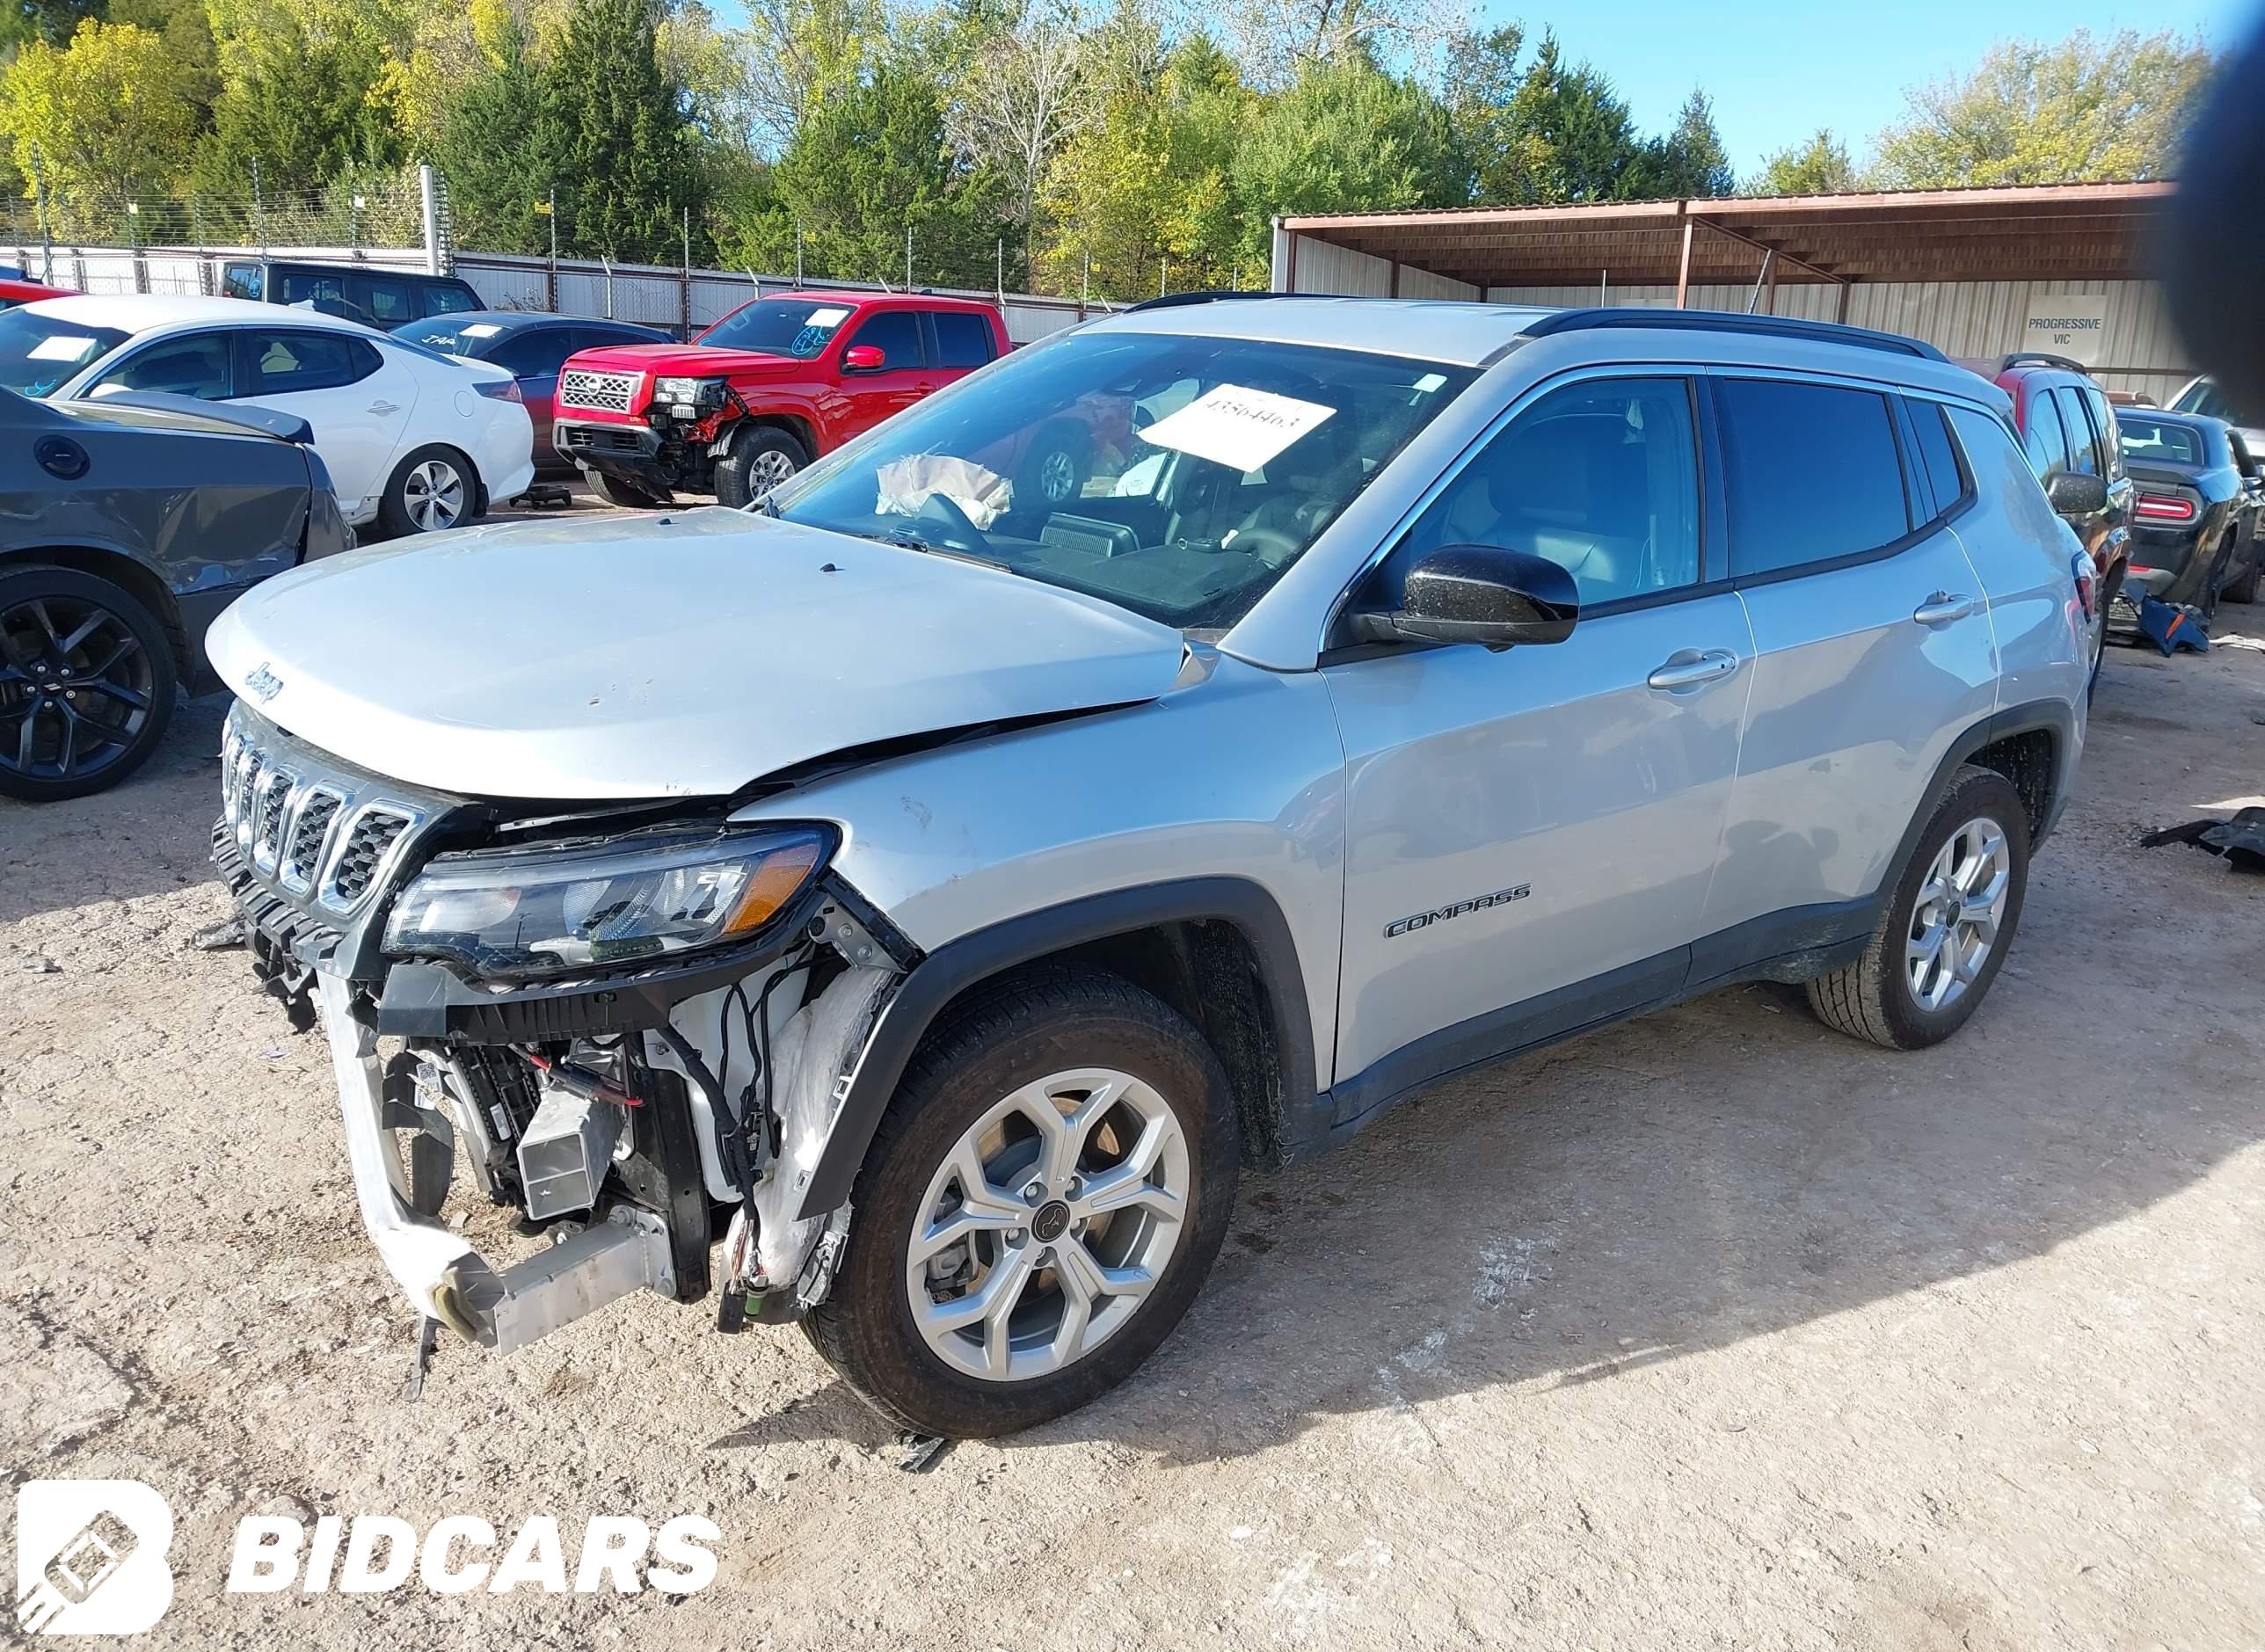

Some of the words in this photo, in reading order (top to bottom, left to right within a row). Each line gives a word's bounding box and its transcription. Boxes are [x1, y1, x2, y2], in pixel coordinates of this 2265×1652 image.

[2028, 317, 2102, 330] PROGRESSIVE
[2053, 333, 2072, 345] VIC
[1384, 883, 1533, 939] COMPASS
